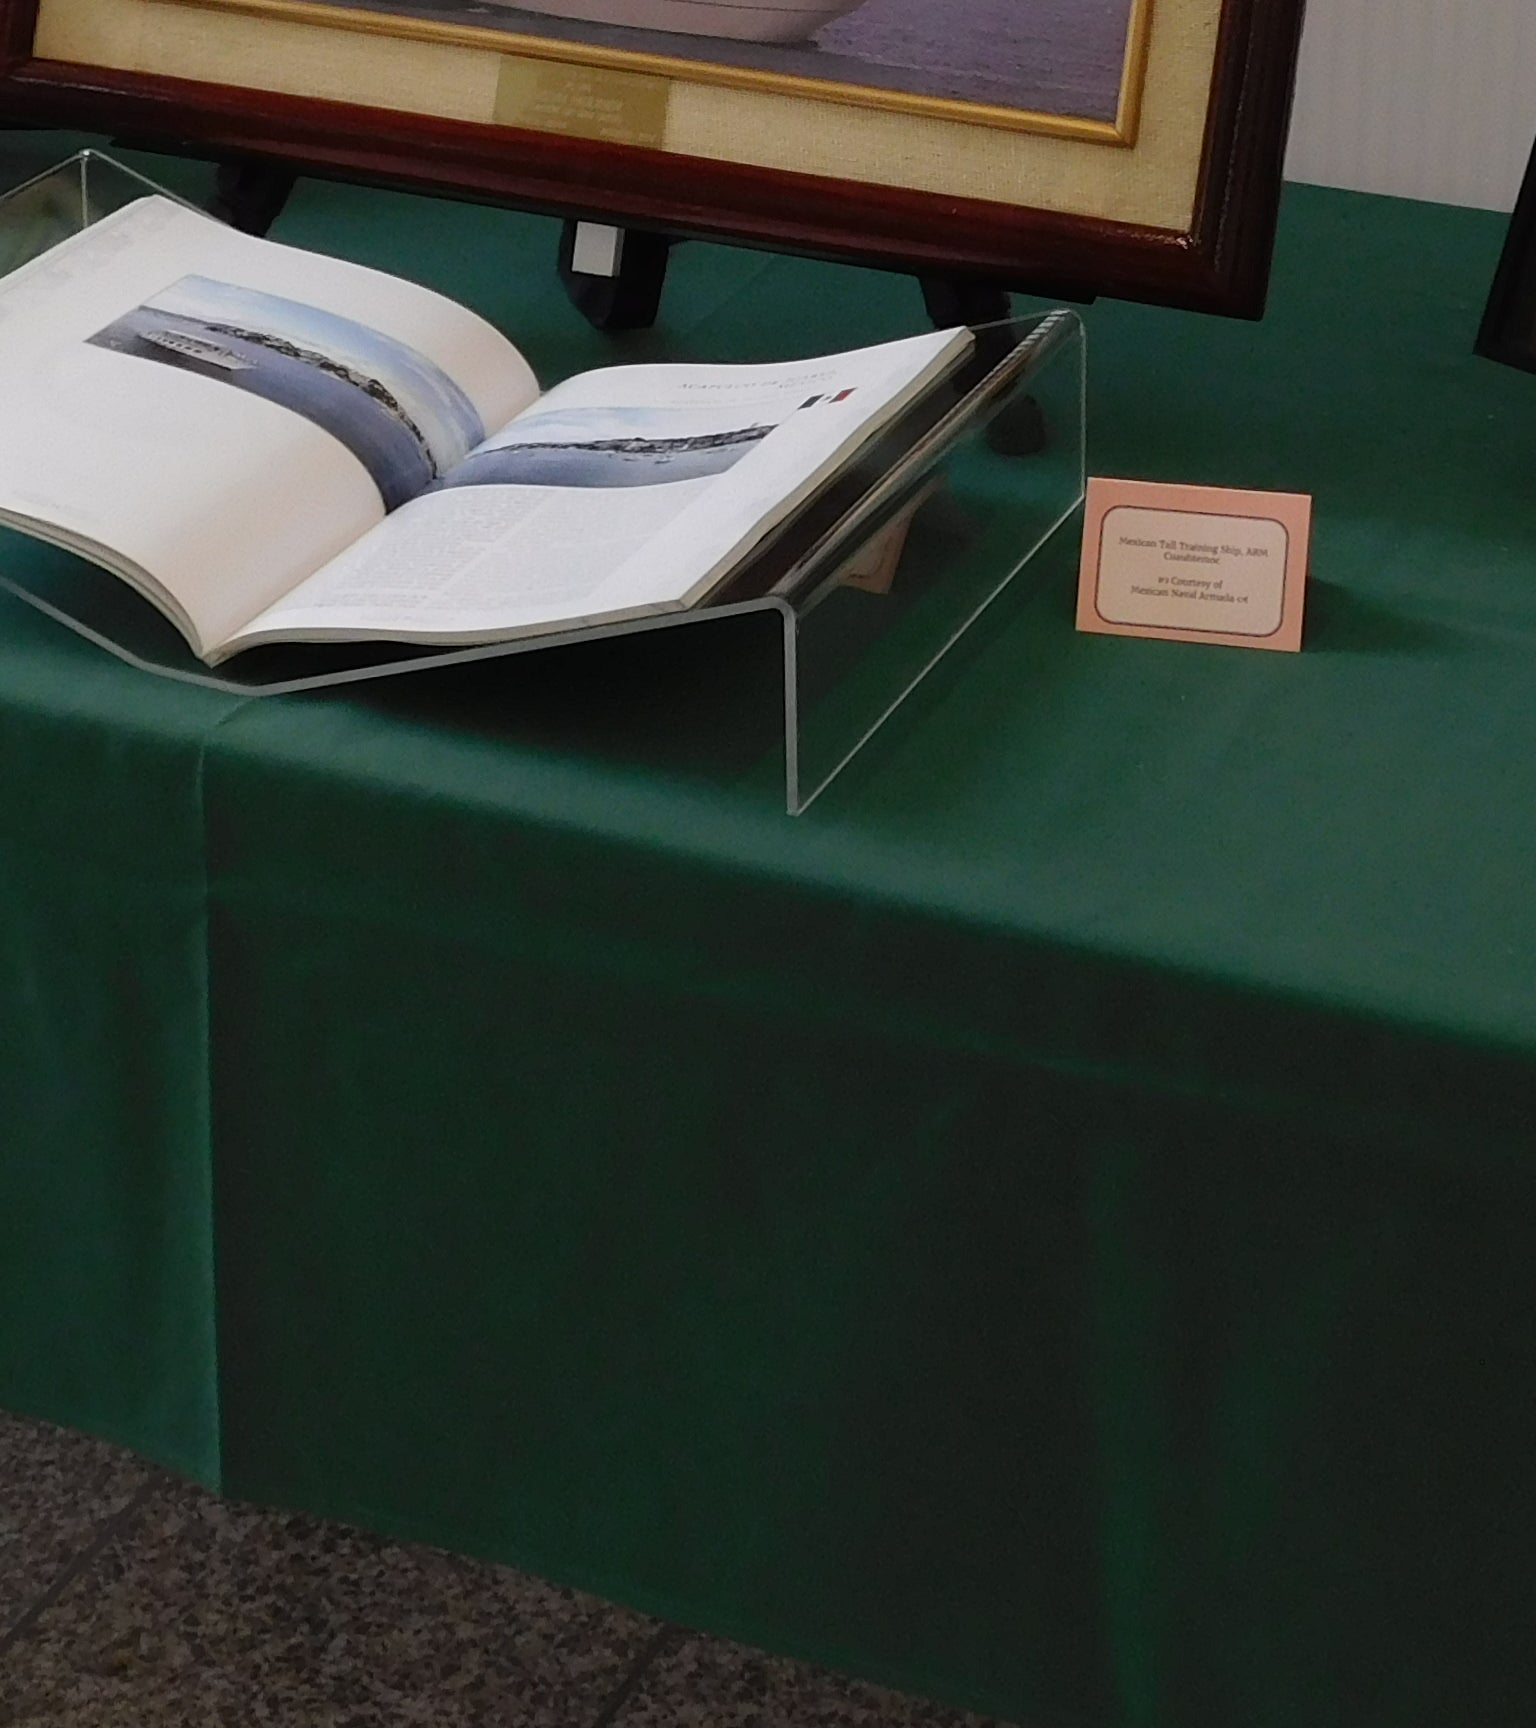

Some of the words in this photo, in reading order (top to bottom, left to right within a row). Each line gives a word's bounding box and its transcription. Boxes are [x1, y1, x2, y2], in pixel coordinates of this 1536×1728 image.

[1119, 537, 1157, 548] Mexican
[1159, 539, 1177, 549] Tall
[1179, 541, 1218, 554] Training
[1246, 547, 1268, 558] ARM
[1171, 576, 1211, 589] Courtesy
[1213, 579, 1222, 589] of
[1131, 585, 1169, 597] Mexican
[1171, 588, 1196, 600] Naval
